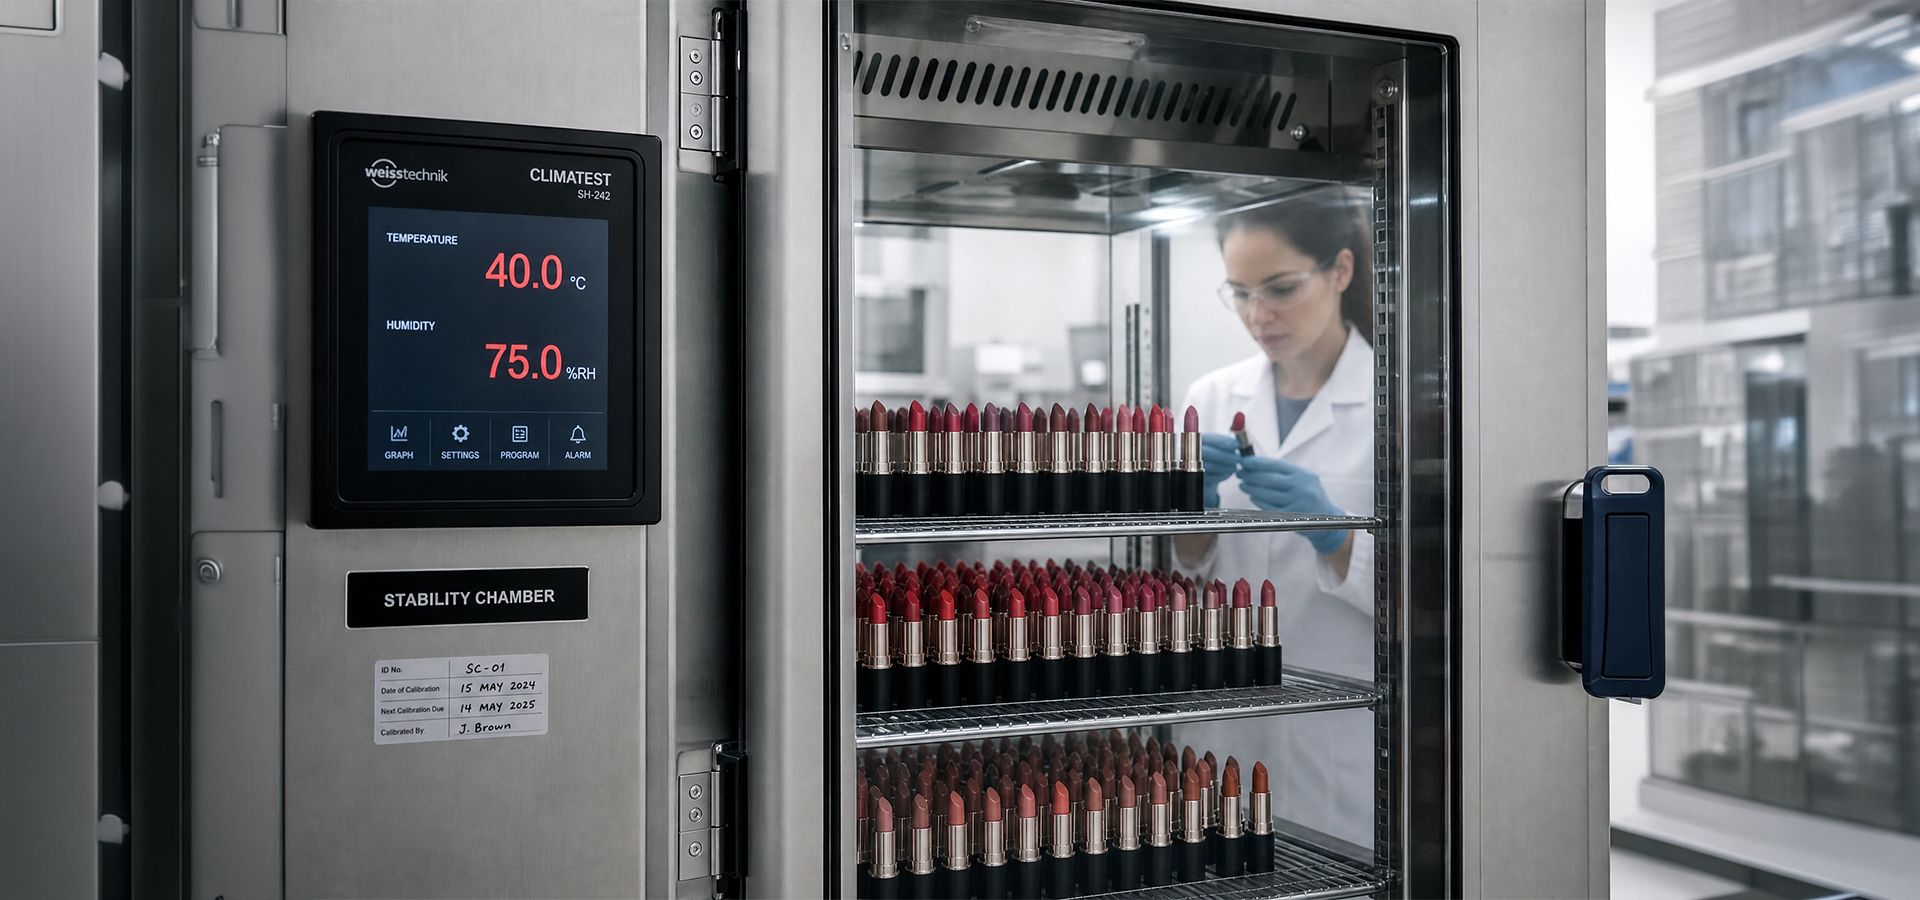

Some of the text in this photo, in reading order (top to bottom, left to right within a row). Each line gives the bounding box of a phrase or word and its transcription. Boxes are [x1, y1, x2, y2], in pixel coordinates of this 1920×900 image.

[365, 164, 448, 184] weisstechnik
[530, 168, 612, 186] CLIMATEST
[577, 189, 611, 201] SH-242
[386, 232, 458, 245] TEMPERATURE
[485, 252, 586, 290] 40.0 °C
[386, 319, 436, 331] HUMIDITY
[485, 343, 596, 380] 75.0 %RH
[384, 450, 414, 460] GRAPH
[441, 450, 480, 460] SETTINGS
[500, 450, 540, 460] PROGRAM
[564, 450, 592, 460] ALARM
[384, 589, 555, 608] STABILITY CHAMBER
[381, 666, 389, 674] ID
[381, 687, 397, 695] Date
[460, 680, 536, 693] 15 MAY 2024
[397, 706, 431, 714] Calibration
[431, 705, 445, 713] Due
[460, 699, 536, 713] 14 MAY 2025
[381, 727, 424, 736] Calibrated By
[459, 722, 512, 735] J. Brown
